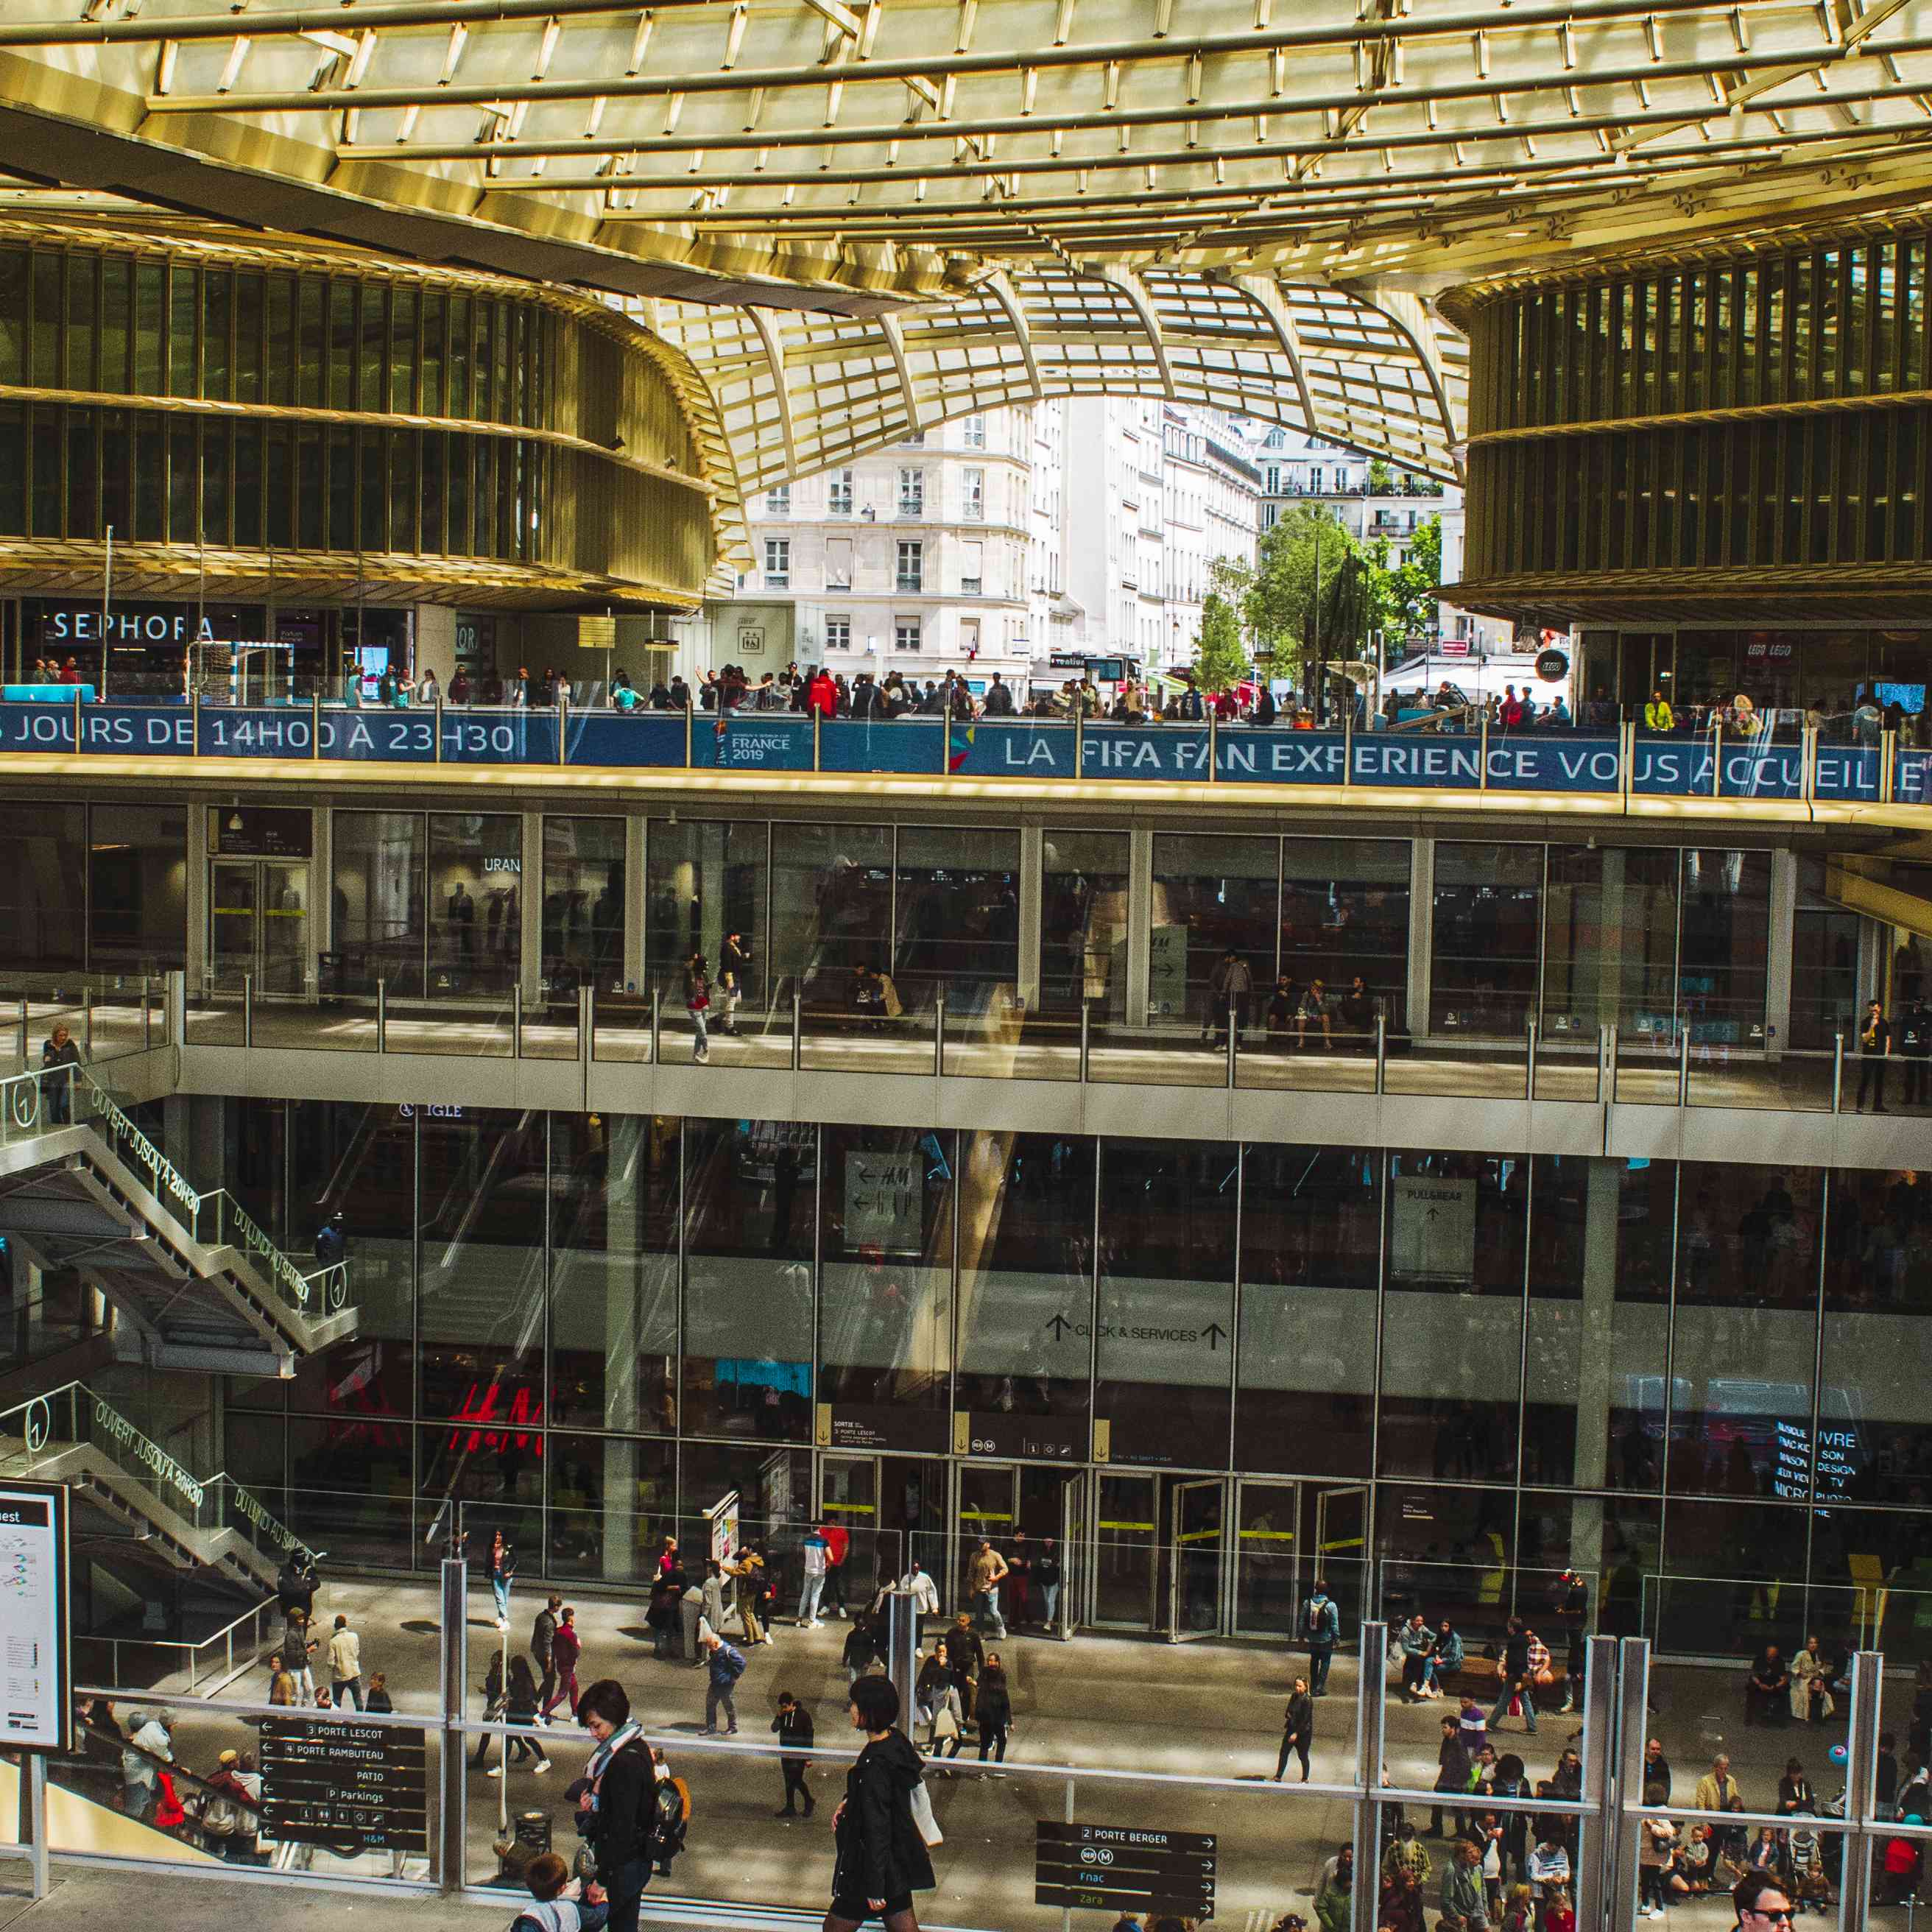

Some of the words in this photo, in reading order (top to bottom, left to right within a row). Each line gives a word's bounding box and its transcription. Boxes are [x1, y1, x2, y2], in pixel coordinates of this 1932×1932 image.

[54, 613, 214, 641] SEPHORA
[1748, 644, 1766, 655] LEGO
[1769, 645, 1791, 656] LEGO
[1543, 663, 1560, 671] LEGO
[15, 716, 134, 743] JOURS
[147, 719, 194, 744] DE
[212, 719, 336, 749] 14H00
[348, 716, 375, 750] À
[389, 724, 515, 752] 23H30
[732, 738, 790, 750] FRANCE
[733, 750, 764, 760] 2019
[1006, 738, 1055, 766] LA
[1082, 739, 1161, 769] FIFA
[1171, 741, 1261, 773] FAN
[1272, 744, 1540, 779] EXPERIENCE
[1559, 752, 1679, 783] VOUS
[91, 1086, 130, 1140] OUVERT
[424, 1104, 462, 1118] IGLE
[1075, 1324, 1115, 1338] CLCK
[1118, 1327, 1128, 1338] &
[1131, 1327, 1197, 1342] SERVICES
[96, 1400, 135, 1448] OUVERT
[174, 1470, 204, 1508] 20H30
[1821, 1450, 1844, 1462] SON
[1817, 1462, 1856, 1476] DESIGN
[1830, 1477, 1844, 1487] TV
[318, 1726, 347, 1737] PORTE
[350, 1729, 384, 1739] LESCOT
[297, 1745, 325, 1755] PORTE
[329, 1747, 384, 1760] RAMBUTEAU
[356, 1771, 384, 1782] PATIO
[341, 1791, 384, 1804] Parkings
[364, 1834, 385, 1844] H&M
[1083, 1829, 1090, 1838] 2
[1095, 1830, 1126, 1841] PORTE
[1129, 1833, 1167, 1844] BERGER
[1080, 1872, 1104, 1883] Fnac
[1079, 1894, 1103, 1905] Zara
